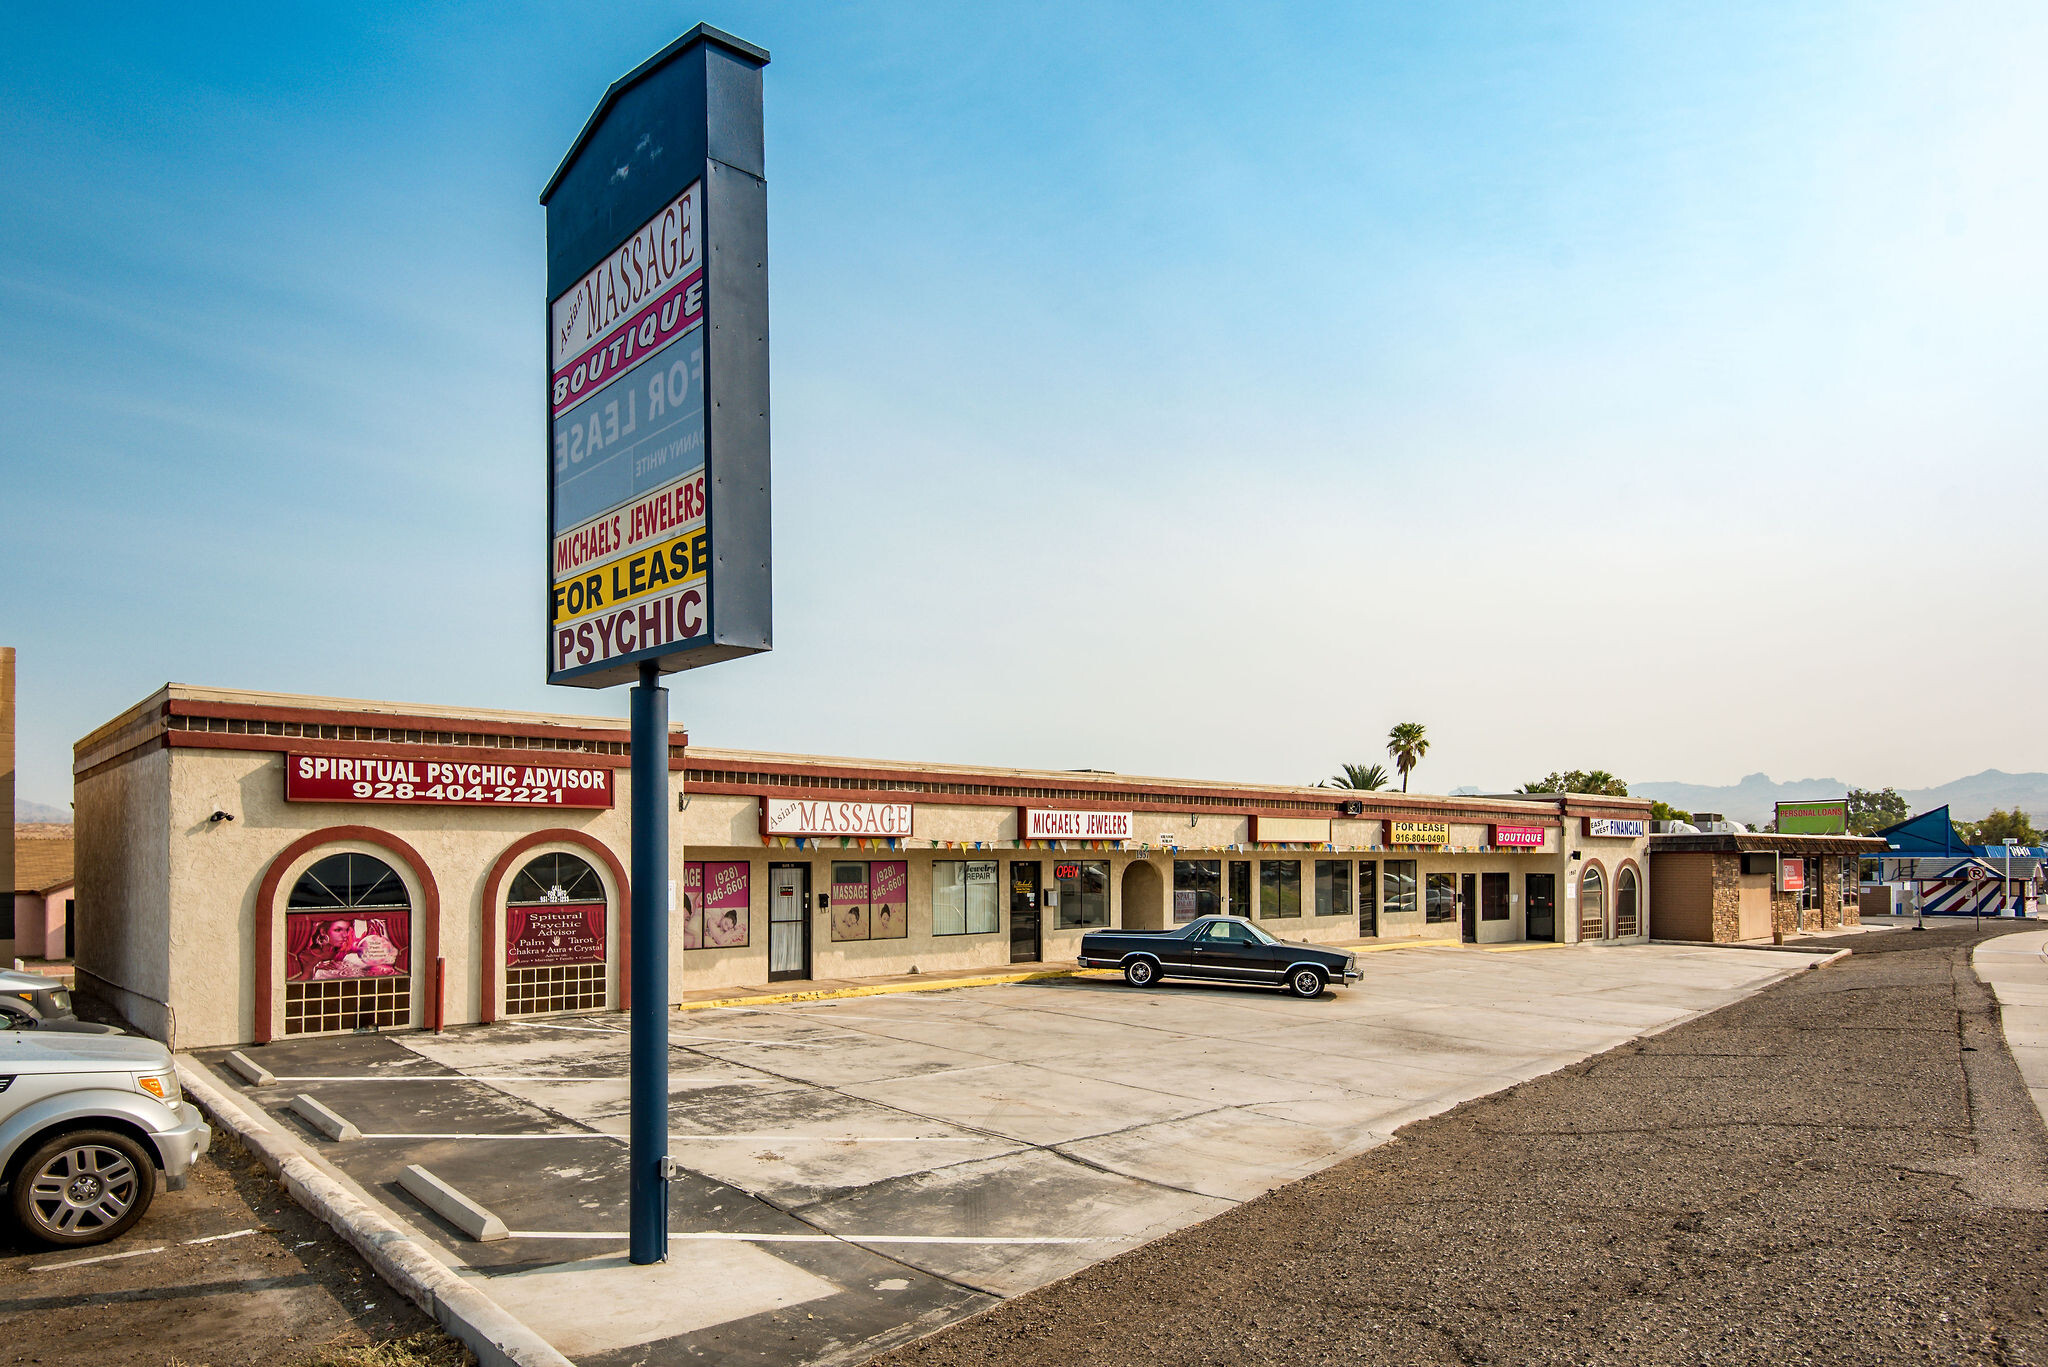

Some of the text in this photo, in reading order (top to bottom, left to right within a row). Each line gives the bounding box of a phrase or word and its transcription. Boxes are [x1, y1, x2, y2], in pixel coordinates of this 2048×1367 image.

[561, 193, 695, 355] Asian MASSAGE
[552, 278, 704, 406] BOUTIQUE
[557, 477, 705, 573] MICHAEL'S JEWELERS
[552, 533, 706, 621] FOR LEASE
[558, 589, 703, 671] PSYCHIC
[299, 757, 605, 790] SPIRITUAL PSYCHIC ADVISOR
[352, 781, 564, 803] 928-404-2221
[769, 801, 910, 834] Asian MASSAGE
[1780, 807, 1843, 817] PERSONAL LOANS
[1033, 813, 1128, 836] MICHAEL'S JEWELERS
[1395, 822, 1445, 832] FOR LEASE
[1590, 819, 1604, 829] EAST
[1595, 825, 1609, 835] WEST
[1610, 820, 1643, 836] FINANCIAL
[1395, 833, 1445, 843] 916-804-0490
[1498, 832, 1542, 842] BOUTIQUE
[715, 865, 739, 887] (928)
[876, 864, 896, 884] (928)
[967, 872, 991, 880] REPAIR
[1056, 865, 1079, 878] OPEN
[706, 874, 748, 905] 846-6607
[832, 884, 868, 900] MASSAGE
[872, 873, 905, 900] 846-6607
[529, 912, 583, 921] Spitural
[532, 921, 581, 930] Psychic
[508, 943, 603, 956] Chakra Aura Crystal
[519, 938, 545, 947] Palm
